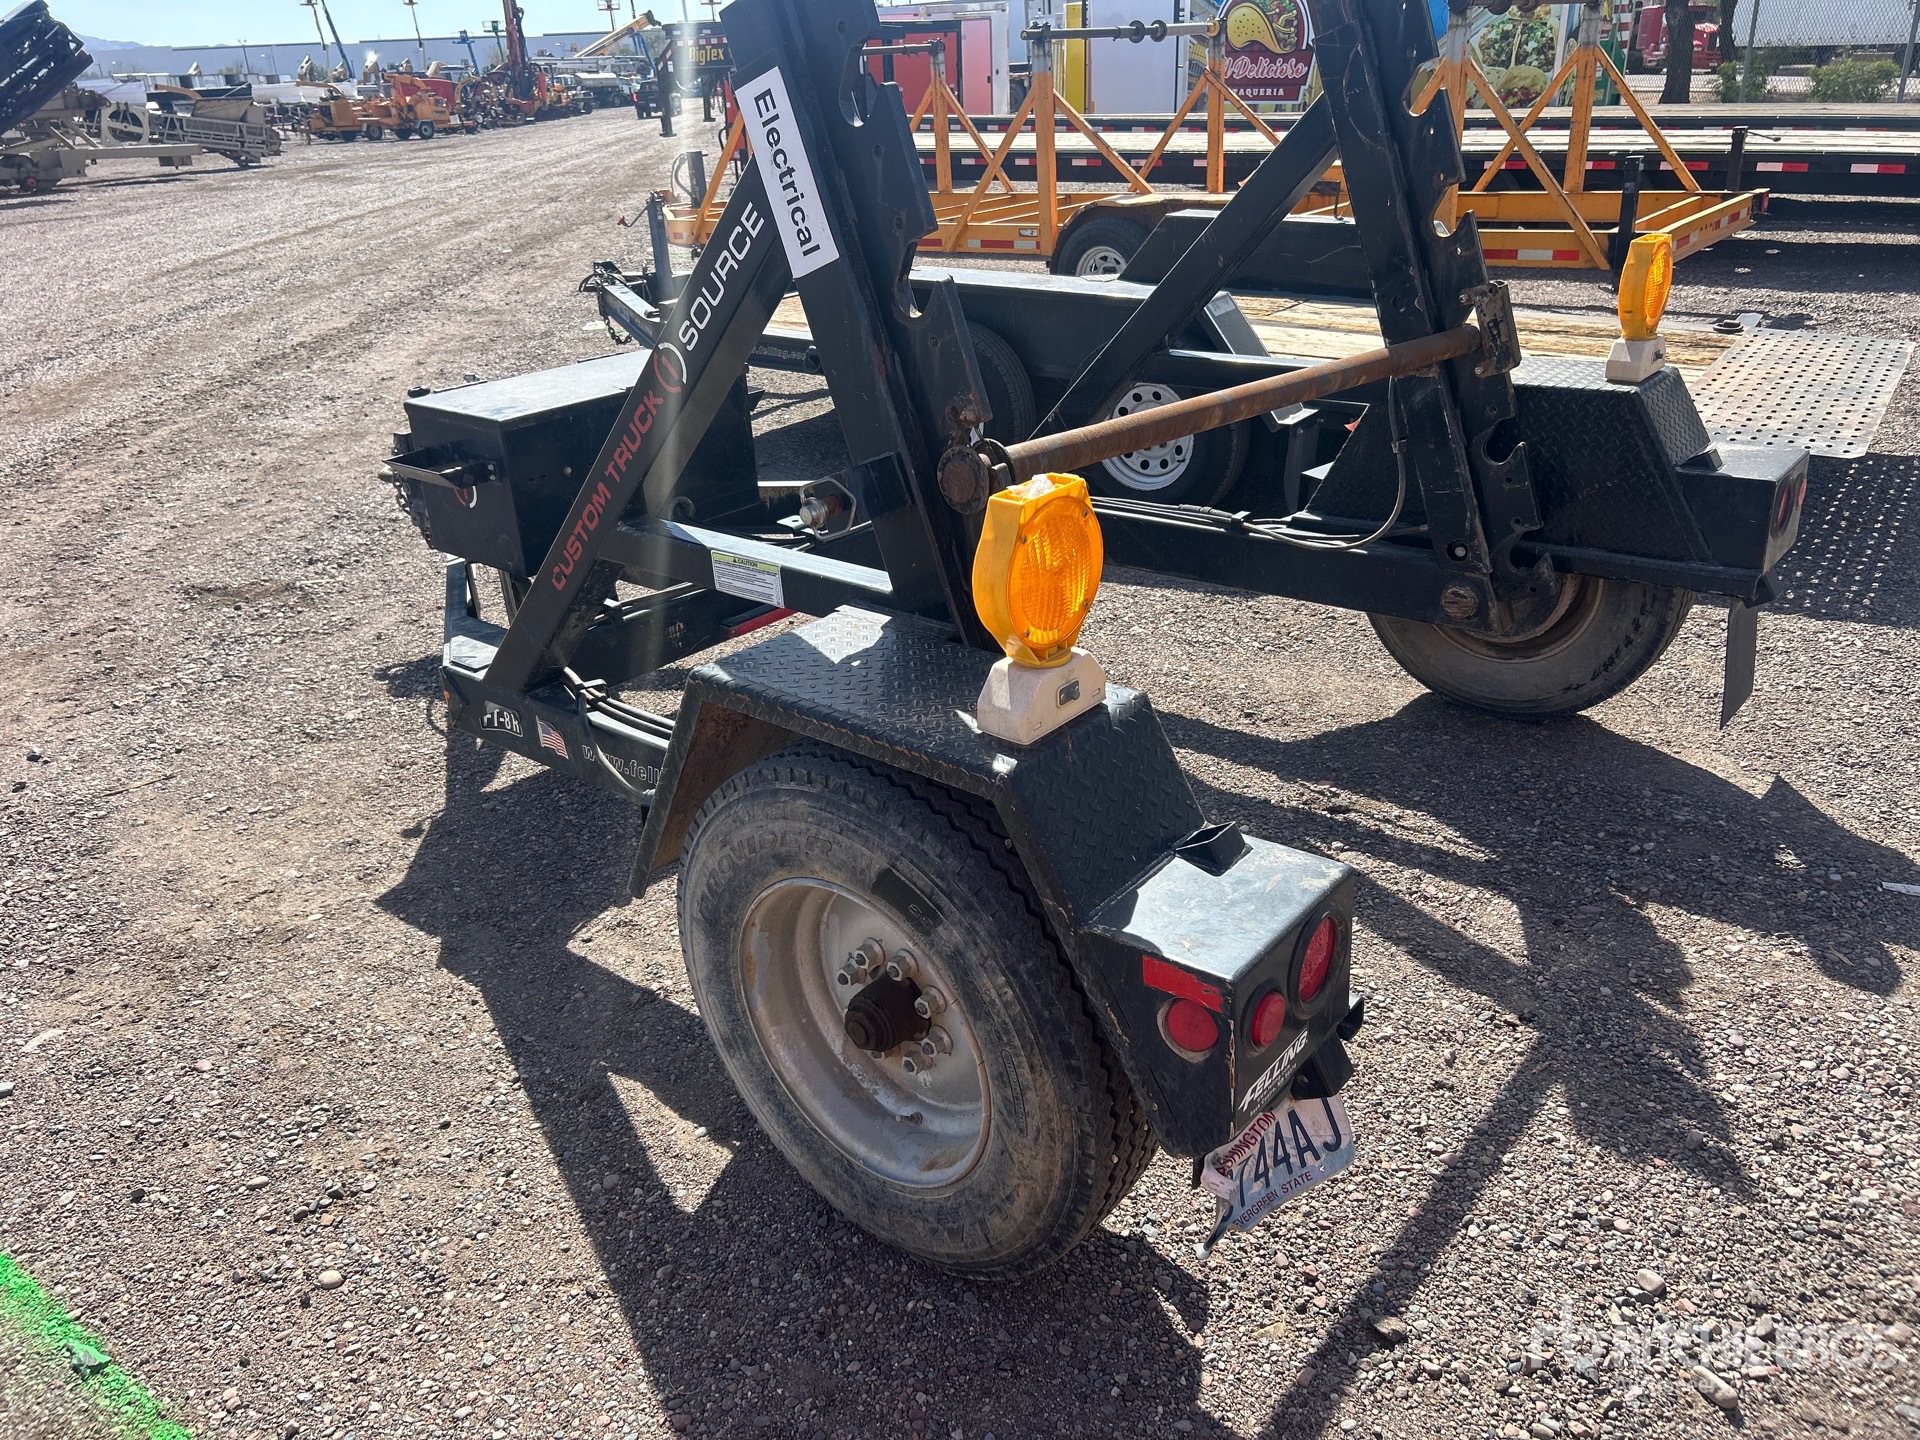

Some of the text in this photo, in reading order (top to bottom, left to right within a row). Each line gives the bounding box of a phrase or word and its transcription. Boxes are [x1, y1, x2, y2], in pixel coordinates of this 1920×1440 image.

[689, 46, 724, 65] BigTex
[1233, 56, 1308, 79] Delicioso
[1233, 88, 1284, 97] TAQUERIA
[754, 88, 821, 257] Electrical
[551, 481, 612, 591] CUSTOM
[604, 390, 664, 483] TRUCK
[678, 202, 765, 351] SOURCE
[738, 559, 758, 567] CAUTION
[1238, 1026, 1308, 1112] FELLING
[1215, 1112, 1276, 1178] ASHINGTON
[1222, 1098, 1342, 1222] 744AJ
[1280, 1171, 1313, 1194] STATE
